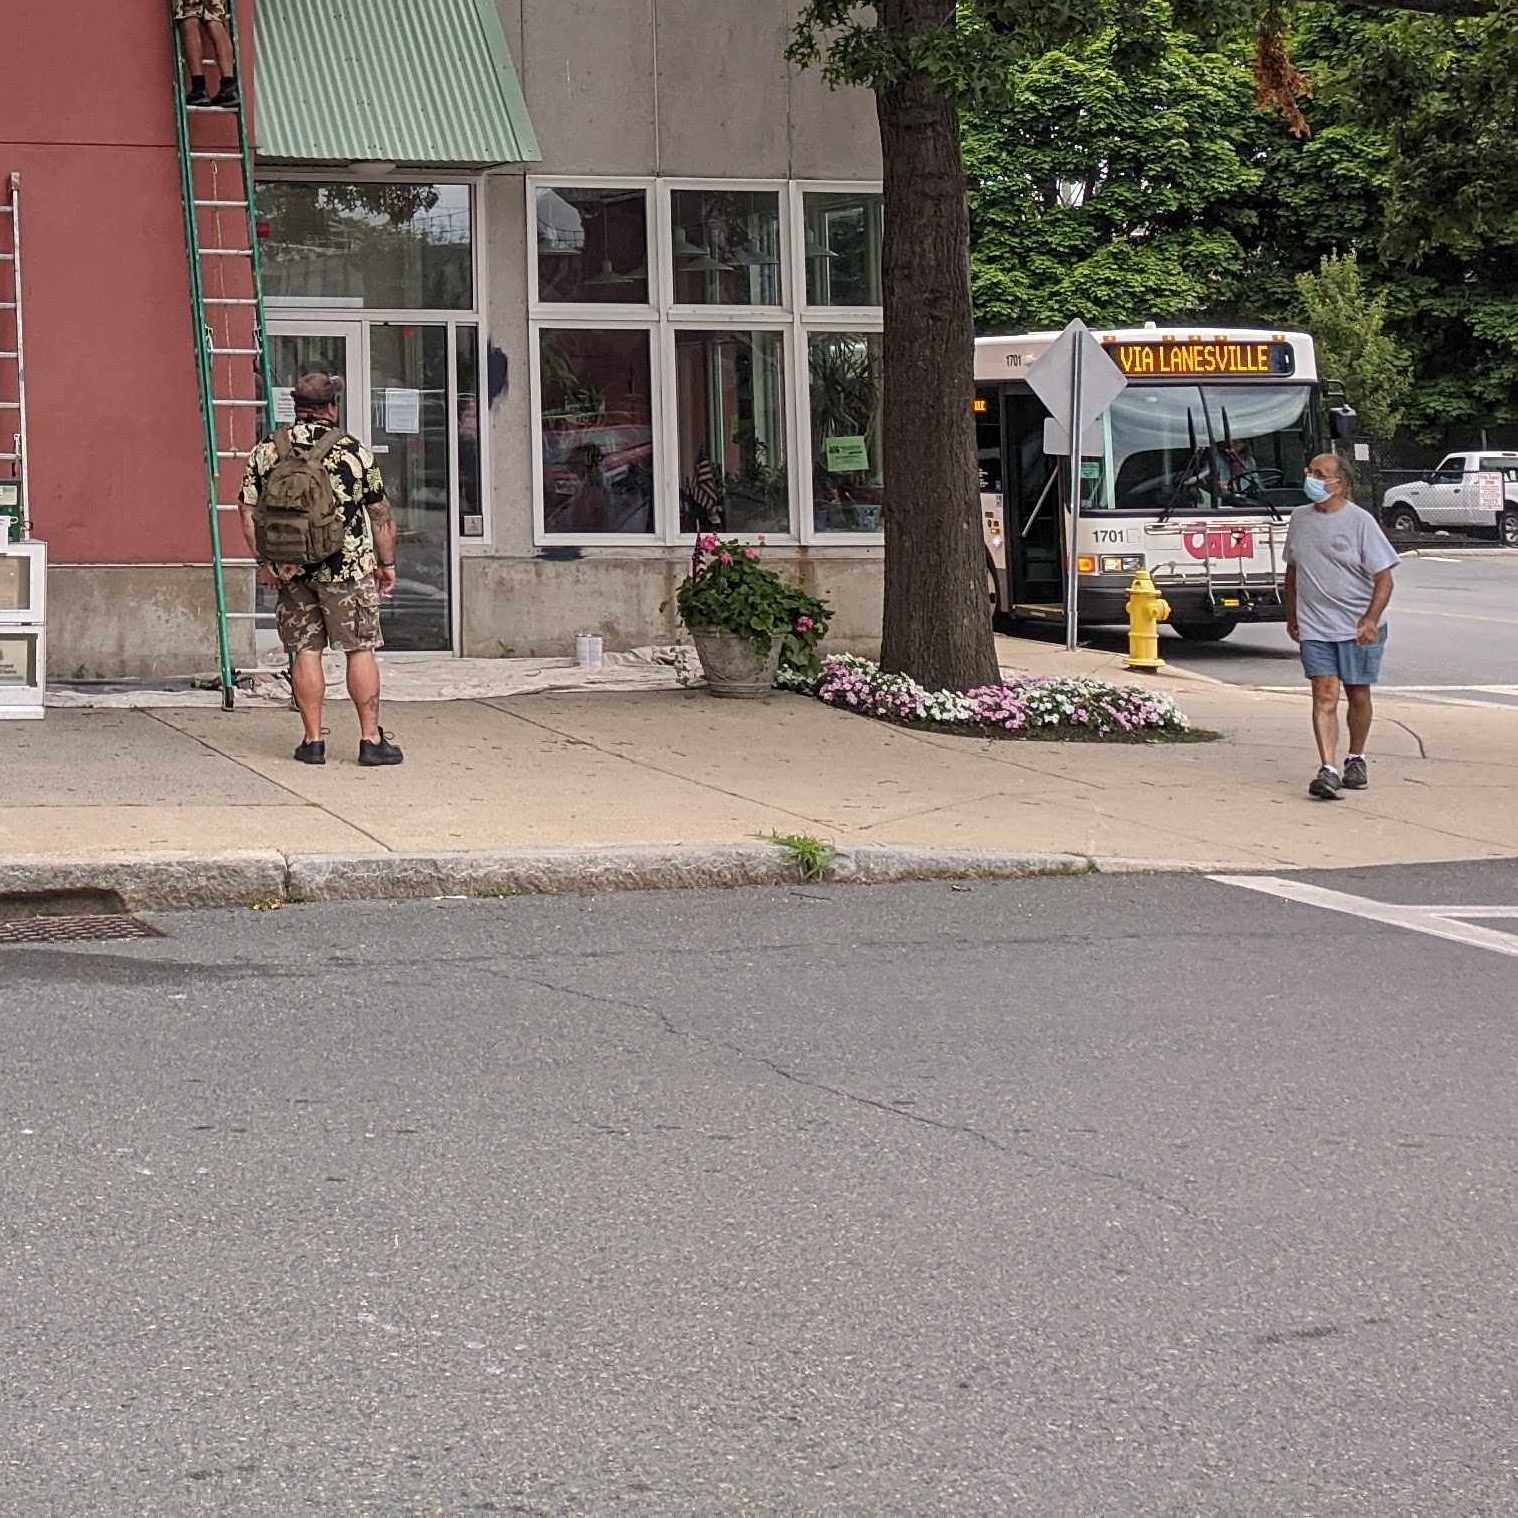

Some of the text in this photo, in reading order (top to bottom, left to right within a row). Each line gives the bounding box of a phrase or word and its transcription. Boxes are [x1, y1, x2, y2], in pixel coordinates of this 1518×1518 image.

[1005, 354, 1022, 367] 1701
[1120, 345, 1268, 372] VIA LANESVILLE
[1093, 530, 1124, 543] 1701
